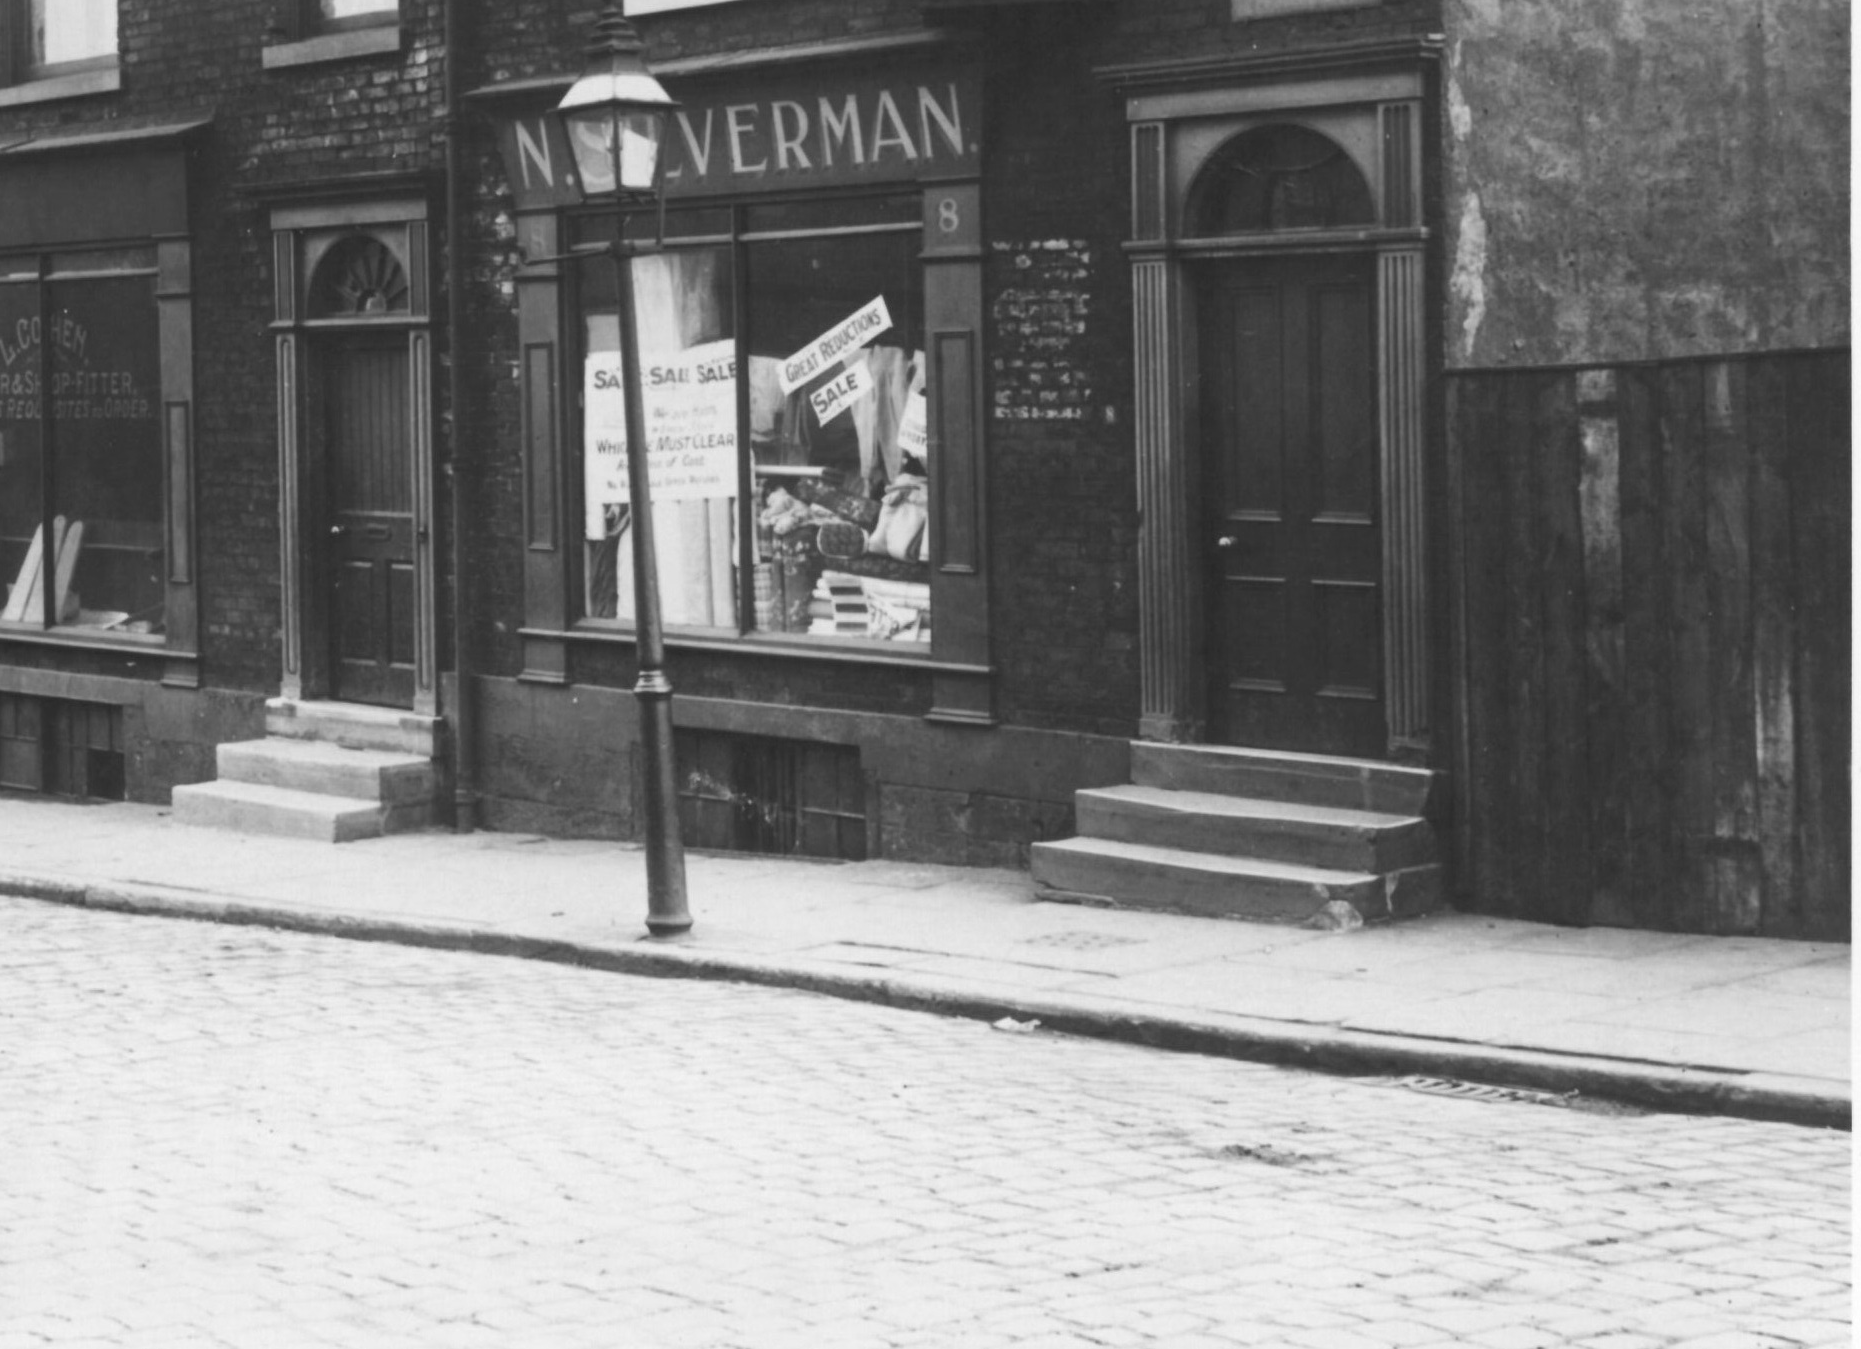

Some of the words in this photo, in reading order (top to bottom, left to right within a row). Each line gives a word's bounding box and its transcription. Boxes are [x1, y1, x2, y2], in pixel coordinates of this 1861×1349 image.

[938, 197, 959, 233] 8
[785, 352, 817, 383] GREAT
[819, 308, 882, 362] REDUCTIONS
[697, 362, 736, 384] SALE
[813, 372, 858, 414] SALE
[597, 439, 628, 455] WHIC
[656, 436, 691, 452] MUST
[692, 433, 735, 450] CLEAR
